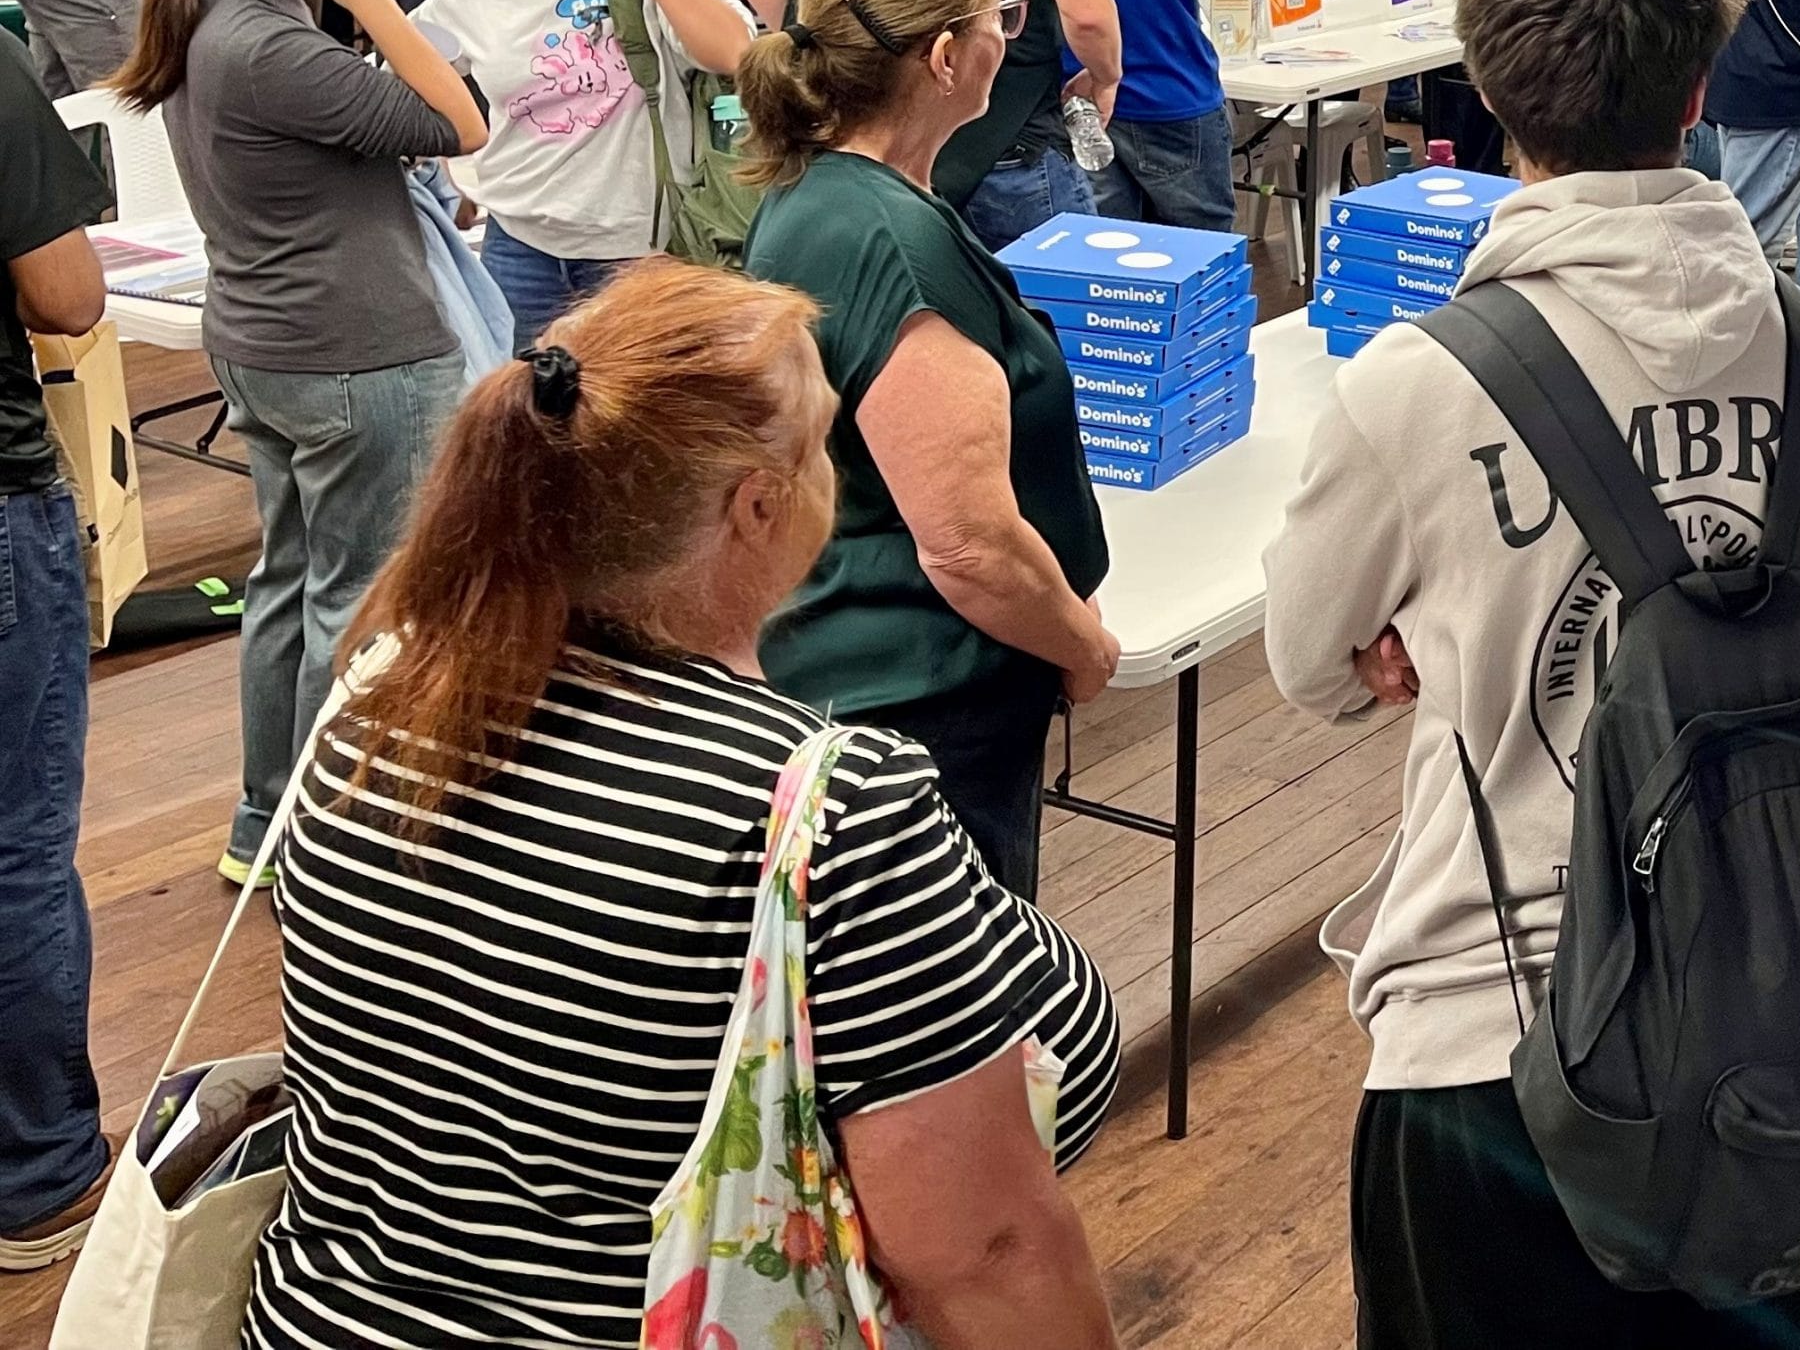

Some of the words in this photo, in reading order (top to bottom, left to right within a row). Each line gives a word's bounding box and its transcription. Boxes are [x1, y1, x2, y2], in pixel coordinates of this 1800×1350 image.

[1407, 220, 1464, 241] Domino's
[1397, 249, 1455, 270] Domino's
[1089, 283, 1167, 304] Domino's
[1397, 275, 1453, 297] Domino's
[1086, 312, 1162, 334] Domino's
[1392, 304, 1426, 320] Domi
[1081, 342, 1155, 366] Domino's
[1074, 374, 1147, 399] Domino's
[1079, 405, 1153, 428] Domino's
[1080, 431, 1151, 455] Domino's
[1087, 464, 1144, 483] omino's
[1470, 396, 1784, 549] UMBR
